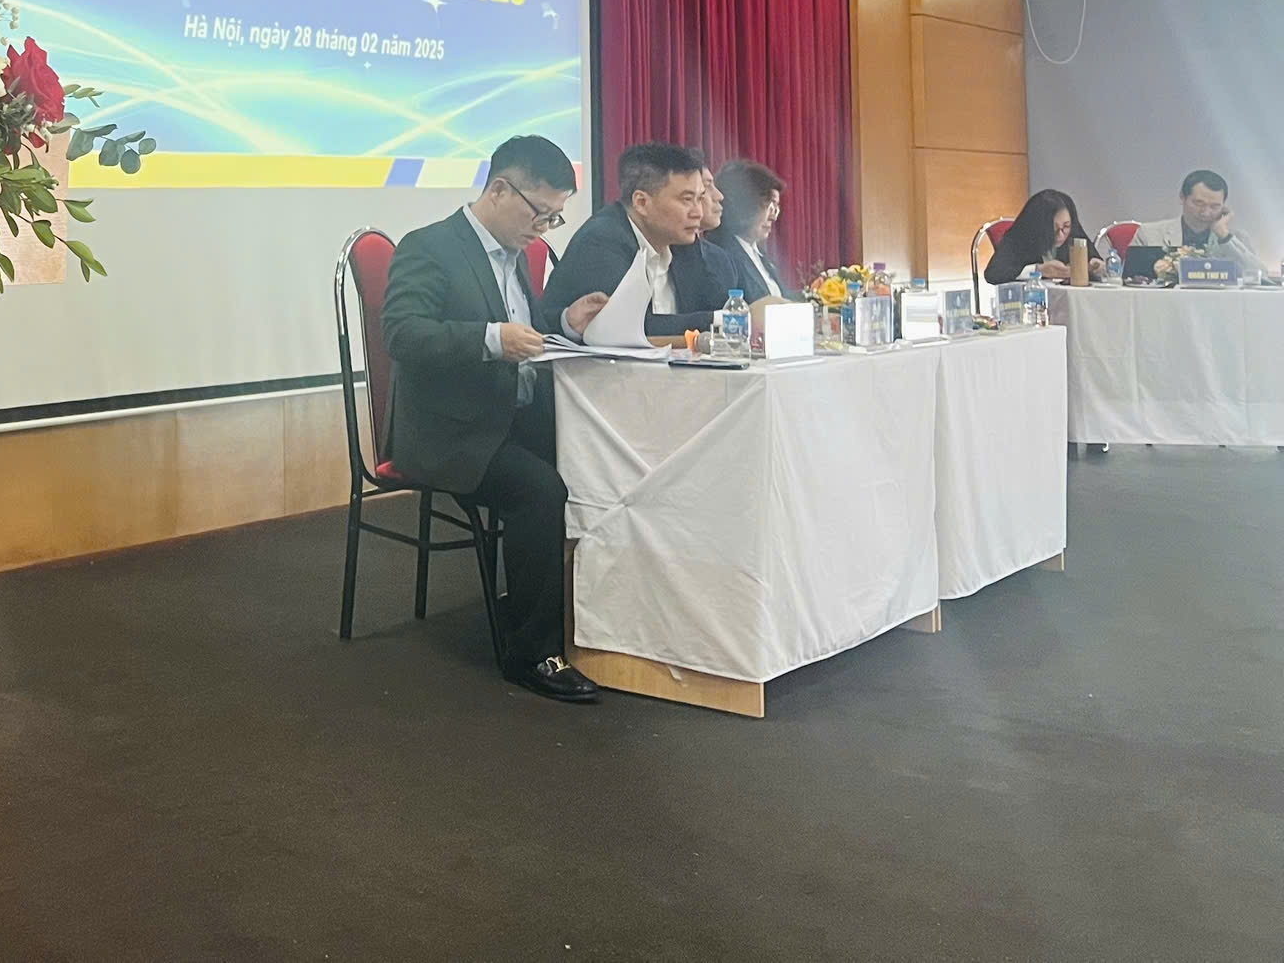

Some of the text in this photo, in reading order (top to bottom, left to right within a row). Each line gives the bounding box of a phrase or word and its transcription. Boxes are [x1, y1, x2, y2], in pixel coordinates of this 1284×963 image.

[184, 14, 445, 61] Hà Nội, ngày 28 tháng 02 năm 2025
